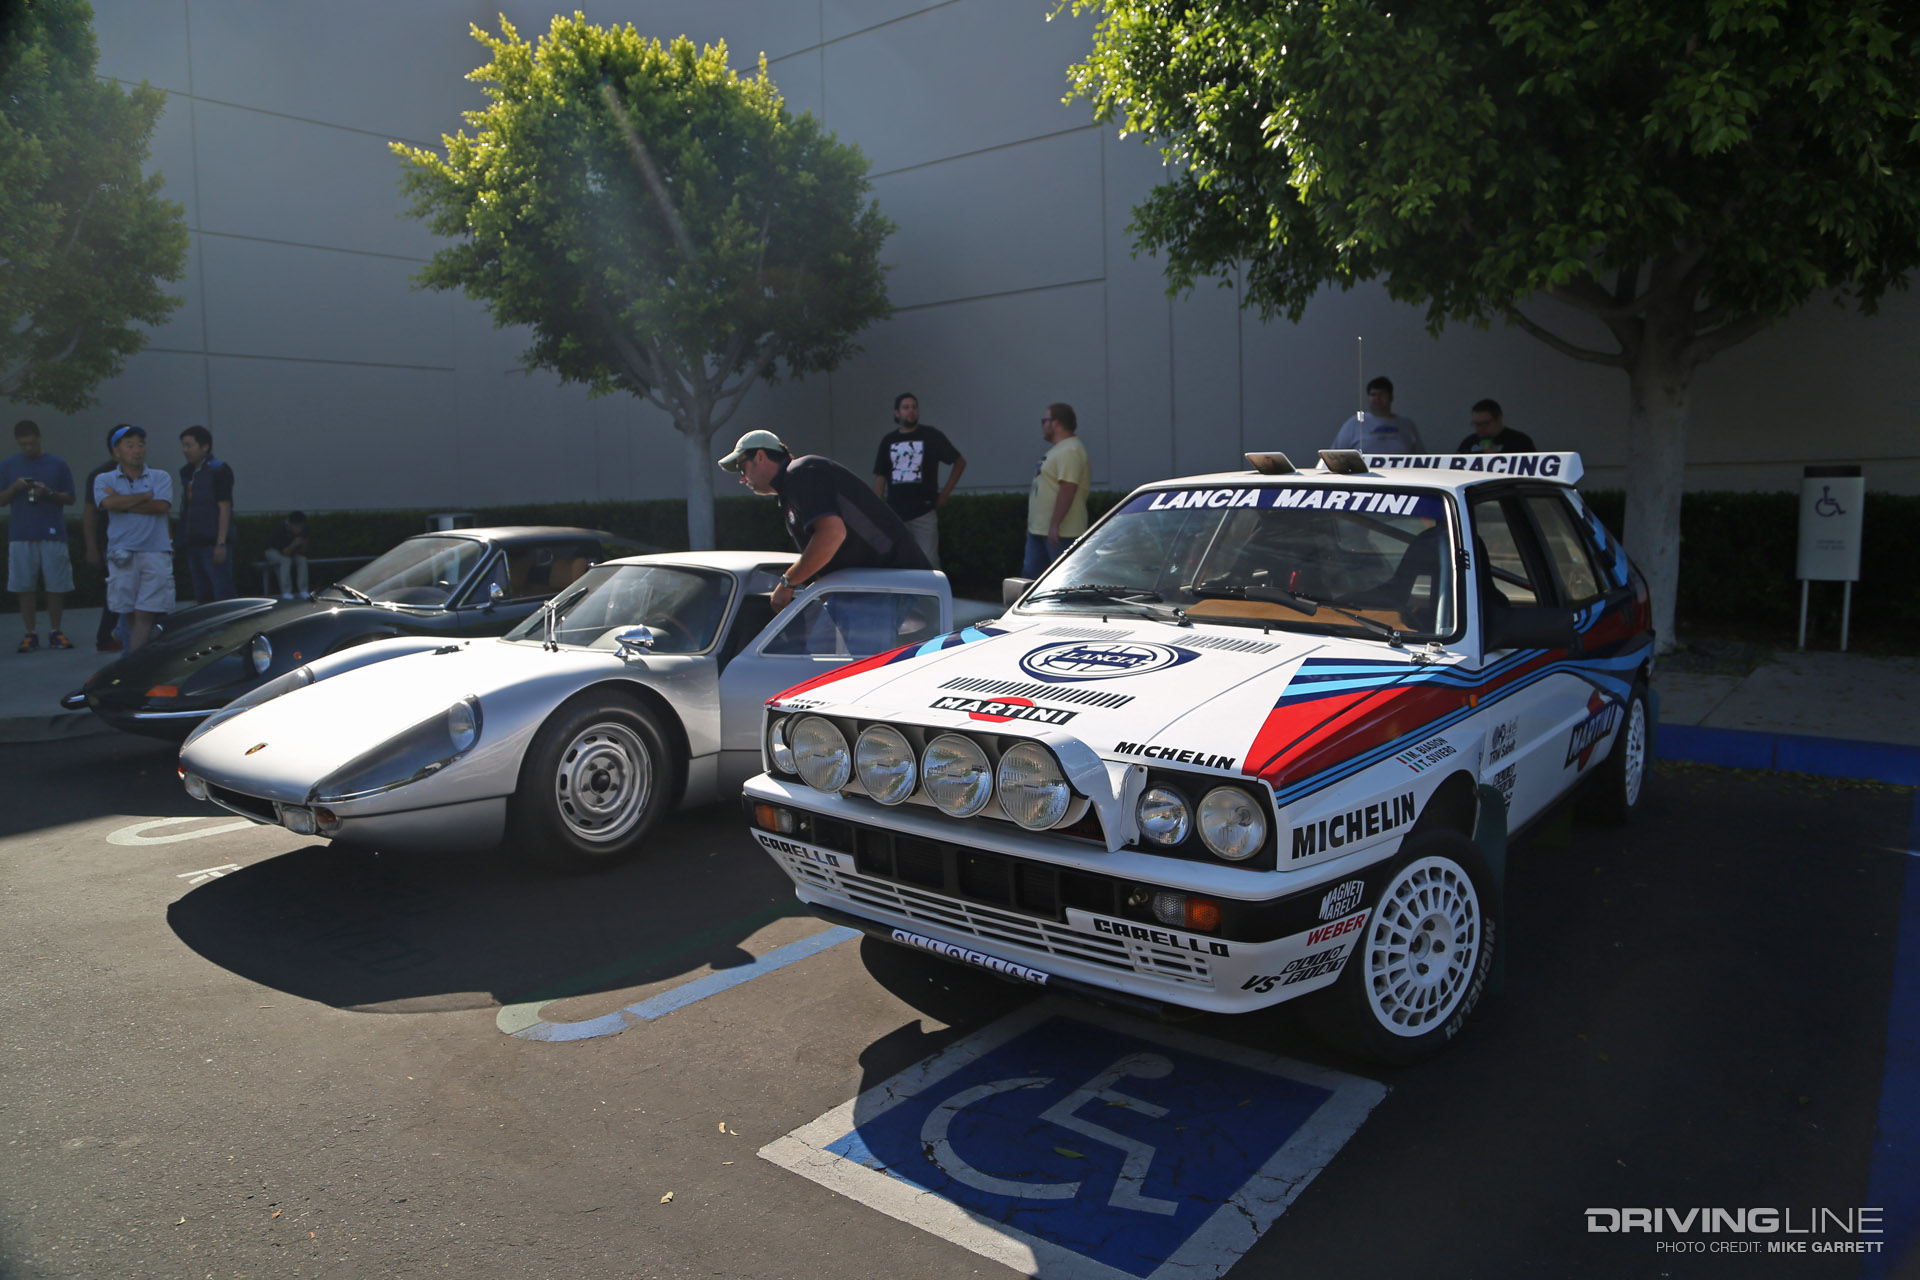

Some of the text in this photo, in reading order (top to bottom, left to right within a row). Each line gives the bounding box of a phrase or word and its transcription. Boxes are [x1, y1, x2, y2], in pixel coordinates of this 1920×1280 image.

[1449, 454, 1561, 477] RACING
[1148, 488, 1420, 516] LANCIA MARTINI
[1063, 650, 1138, 668] LANCIA
[934, 697, 1070, 724] MARTINI
[1569, 703, 1617, 762] MARTINI
[1114, 741, 1236, 771] MICHELIN
[1291, 791, 1416, 860] MICHELIN
[758, 834, 840, 869] CARELLO
[1093, 918, 1230, 957] CARELLO
[1306, 913, 1366, 947] WEBER
[1283, 946, 1344, 973] OLIO
[1286, 957, 1347, 984] FIAT
[1240, 975, 1281, 993] VS
